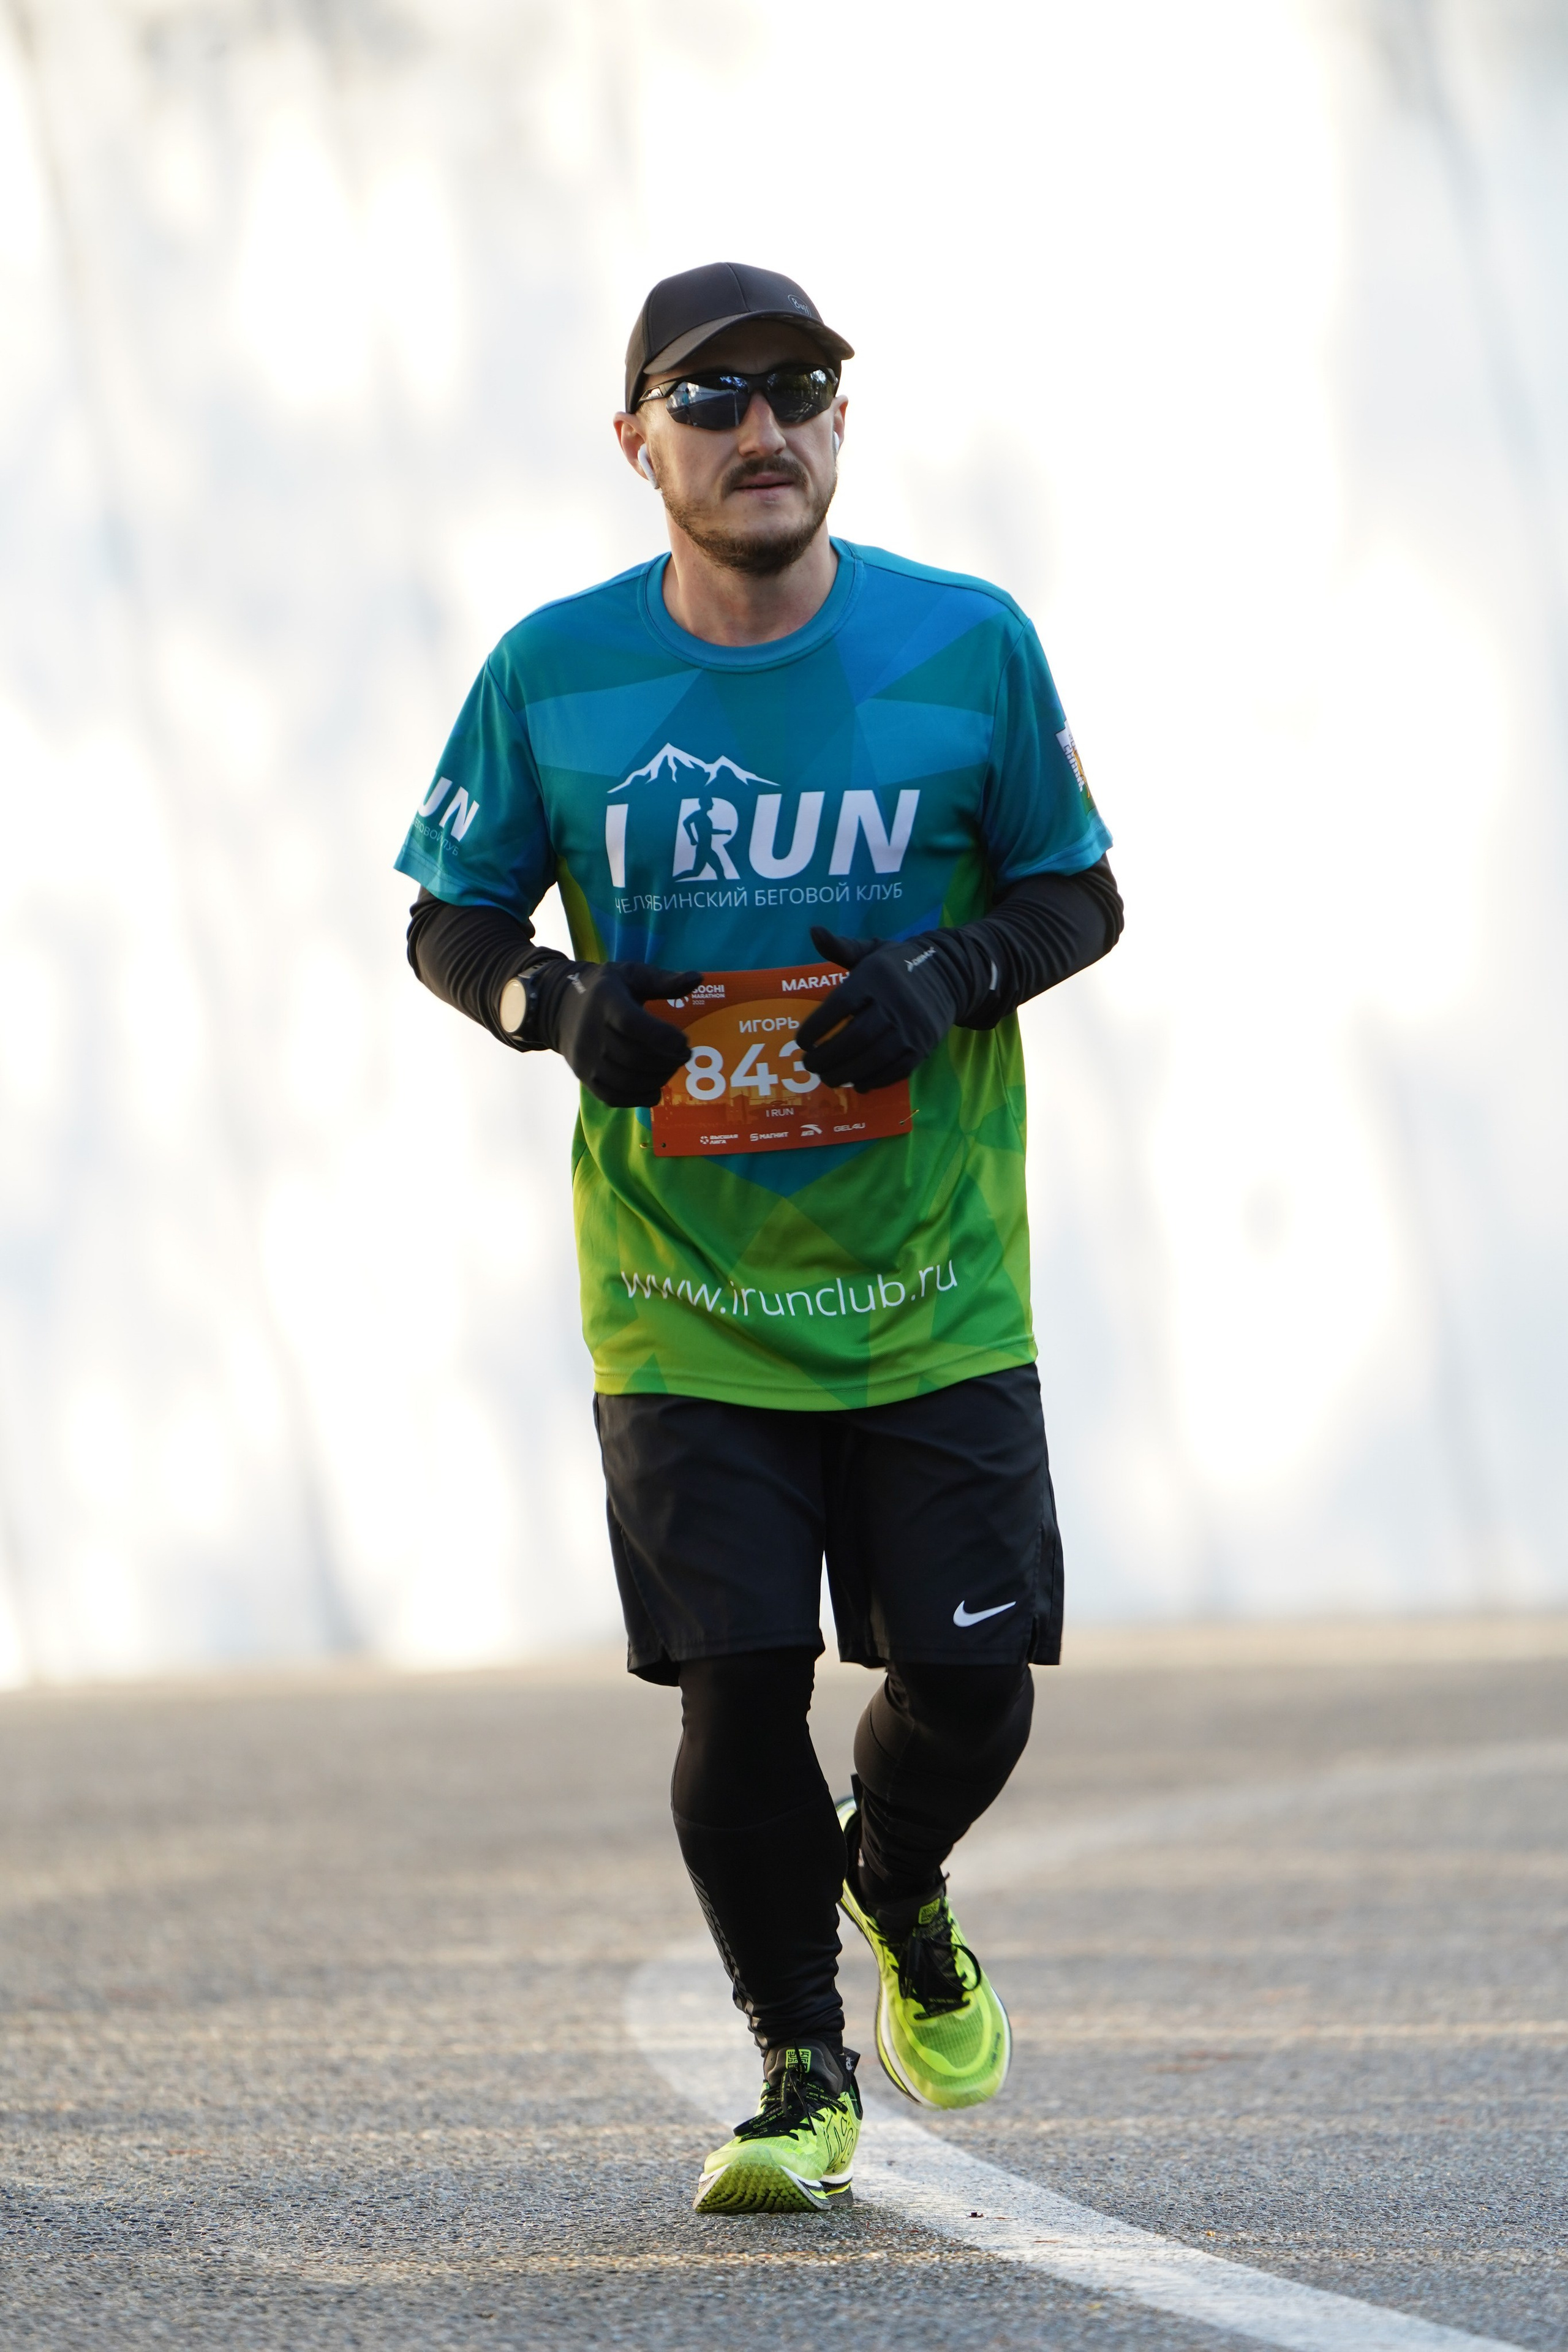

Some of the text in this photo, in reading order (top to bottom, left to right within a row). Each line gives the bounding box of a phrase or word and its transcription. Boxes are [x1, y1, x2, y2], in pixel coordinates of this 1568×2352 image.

[418, 776, 480, 842] UN
[605, 789, 921, 888] I RUN
[615, 882, 903, 914] ЧЕЛЯБИНСКИЙ БЕГОВОЙ КЛУБ
[782, 971, 850, 991] MARATH
[739, 1017, 799, 1033] ИГОРЬ
[685, 1039, 855, 1101] 843
[771, 1107, 794, 1117] RUN
[621, 1260, 958, 1316] www.irunclub.ru
